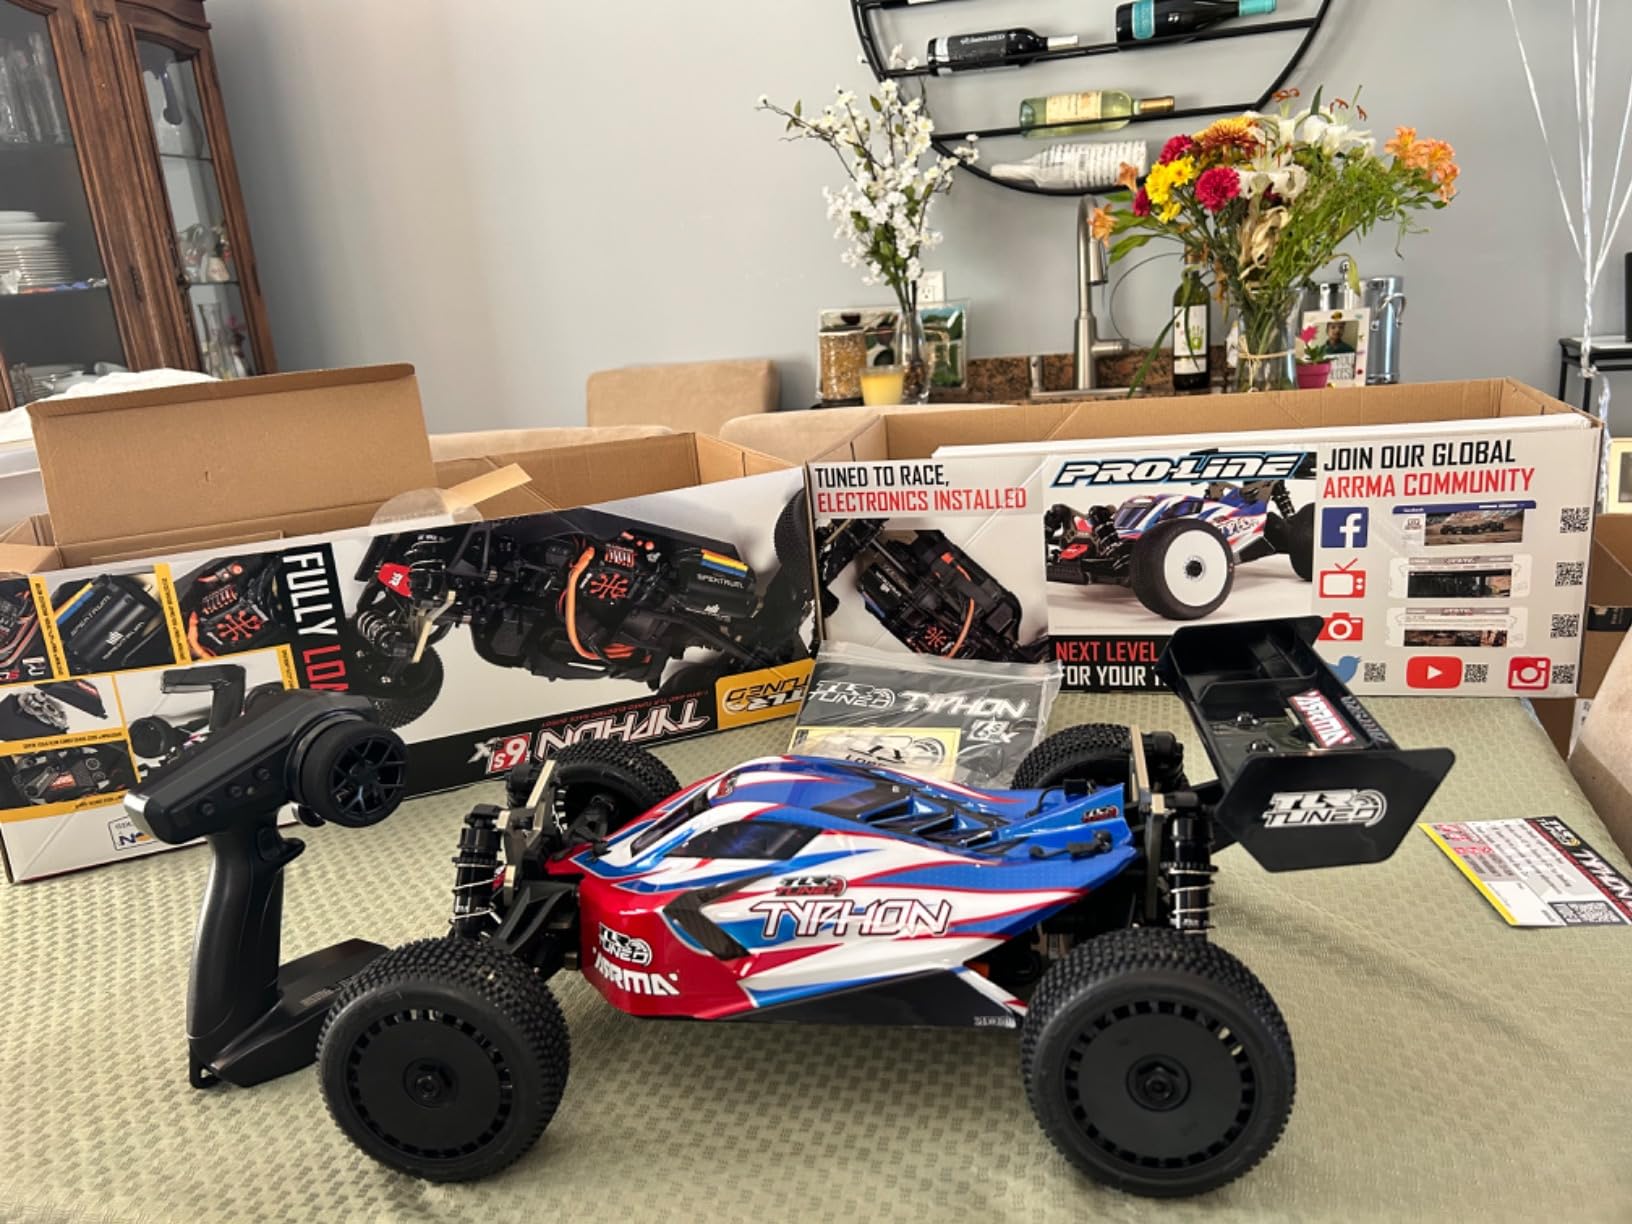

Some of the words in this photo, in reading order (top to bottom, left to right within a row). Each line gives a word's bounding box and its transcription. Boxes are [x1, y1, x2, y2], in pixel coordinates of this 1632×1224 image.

[1323, 447, 1373, 471] JOIN
[1380, 445, 1425, 469] OUR
[1431, 440, 1516, 467] GLOBAL
[815, 467, 868, 488] TUNED
[873, 466, 895, 486] TO
[900, 464, 950, 487] RACE,
[1323, 474, 1396, 499] ARRMA
[1403, 468, 1535, 497] COMMUNITY
[818, 490, 929, 512] ELECTRONICS
[934, 487, 1027, 511] INSTALLED
[282, 551, 339, 636] FULLY
[1056, 641, 1100, 662] NEXT
[1105, 641, 1160, 662] LEVEL
[1096, 665, 1147, 687] YOUR
[898, 689, 1029, 718] TYPHON
[1262, 807, 1381, 828] TUNED
[749, 898, 953, 938] TYPHON
